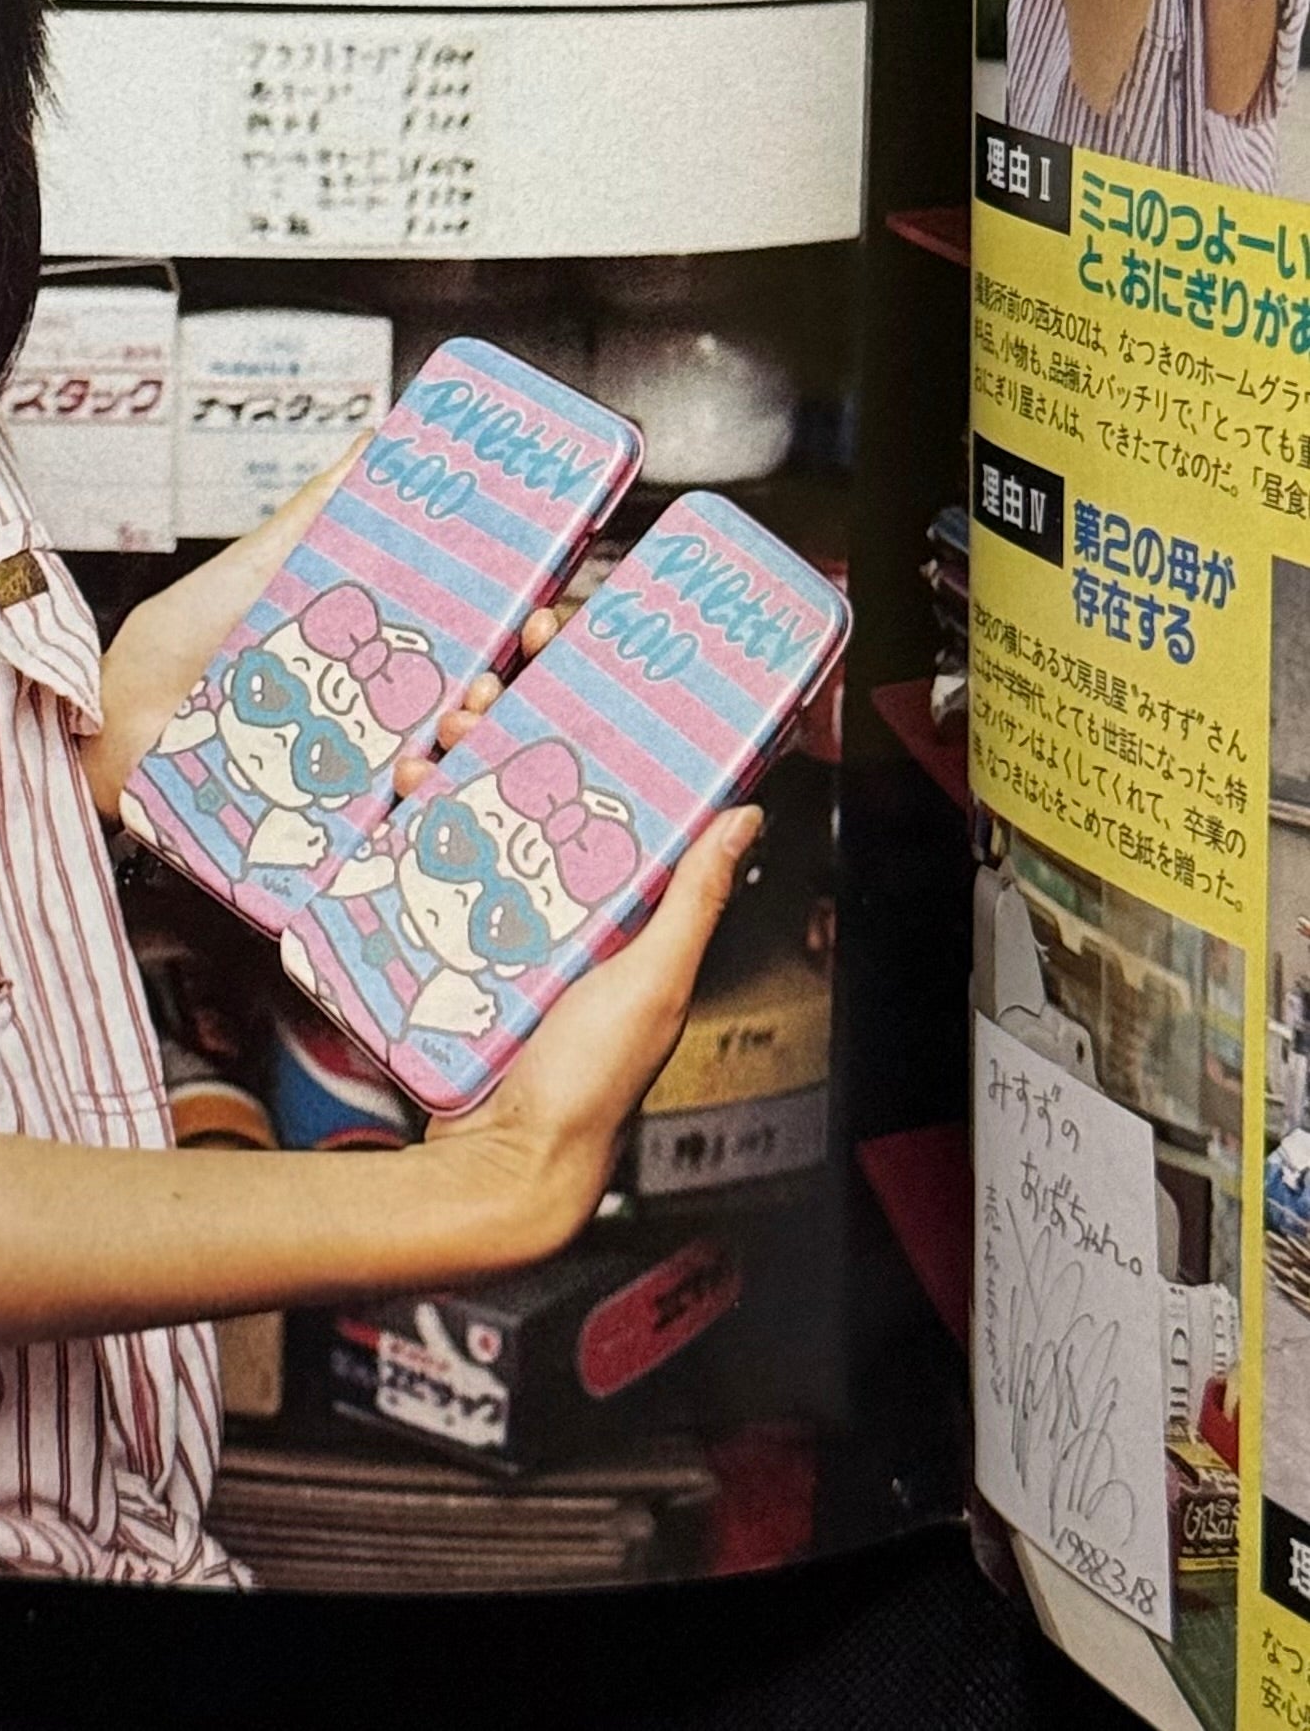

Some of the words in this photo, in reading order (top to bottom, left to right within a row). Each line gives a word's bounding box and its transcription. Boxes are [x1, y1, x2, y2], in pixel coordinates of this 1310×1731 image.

[1072, 498, 1238, 610] 第2の母が
[1071, 565, 1197, 666] 存在する
[987, 1059, 1082, 1153] みすずの
[1260, 1627, 1310, 1688] なつ
